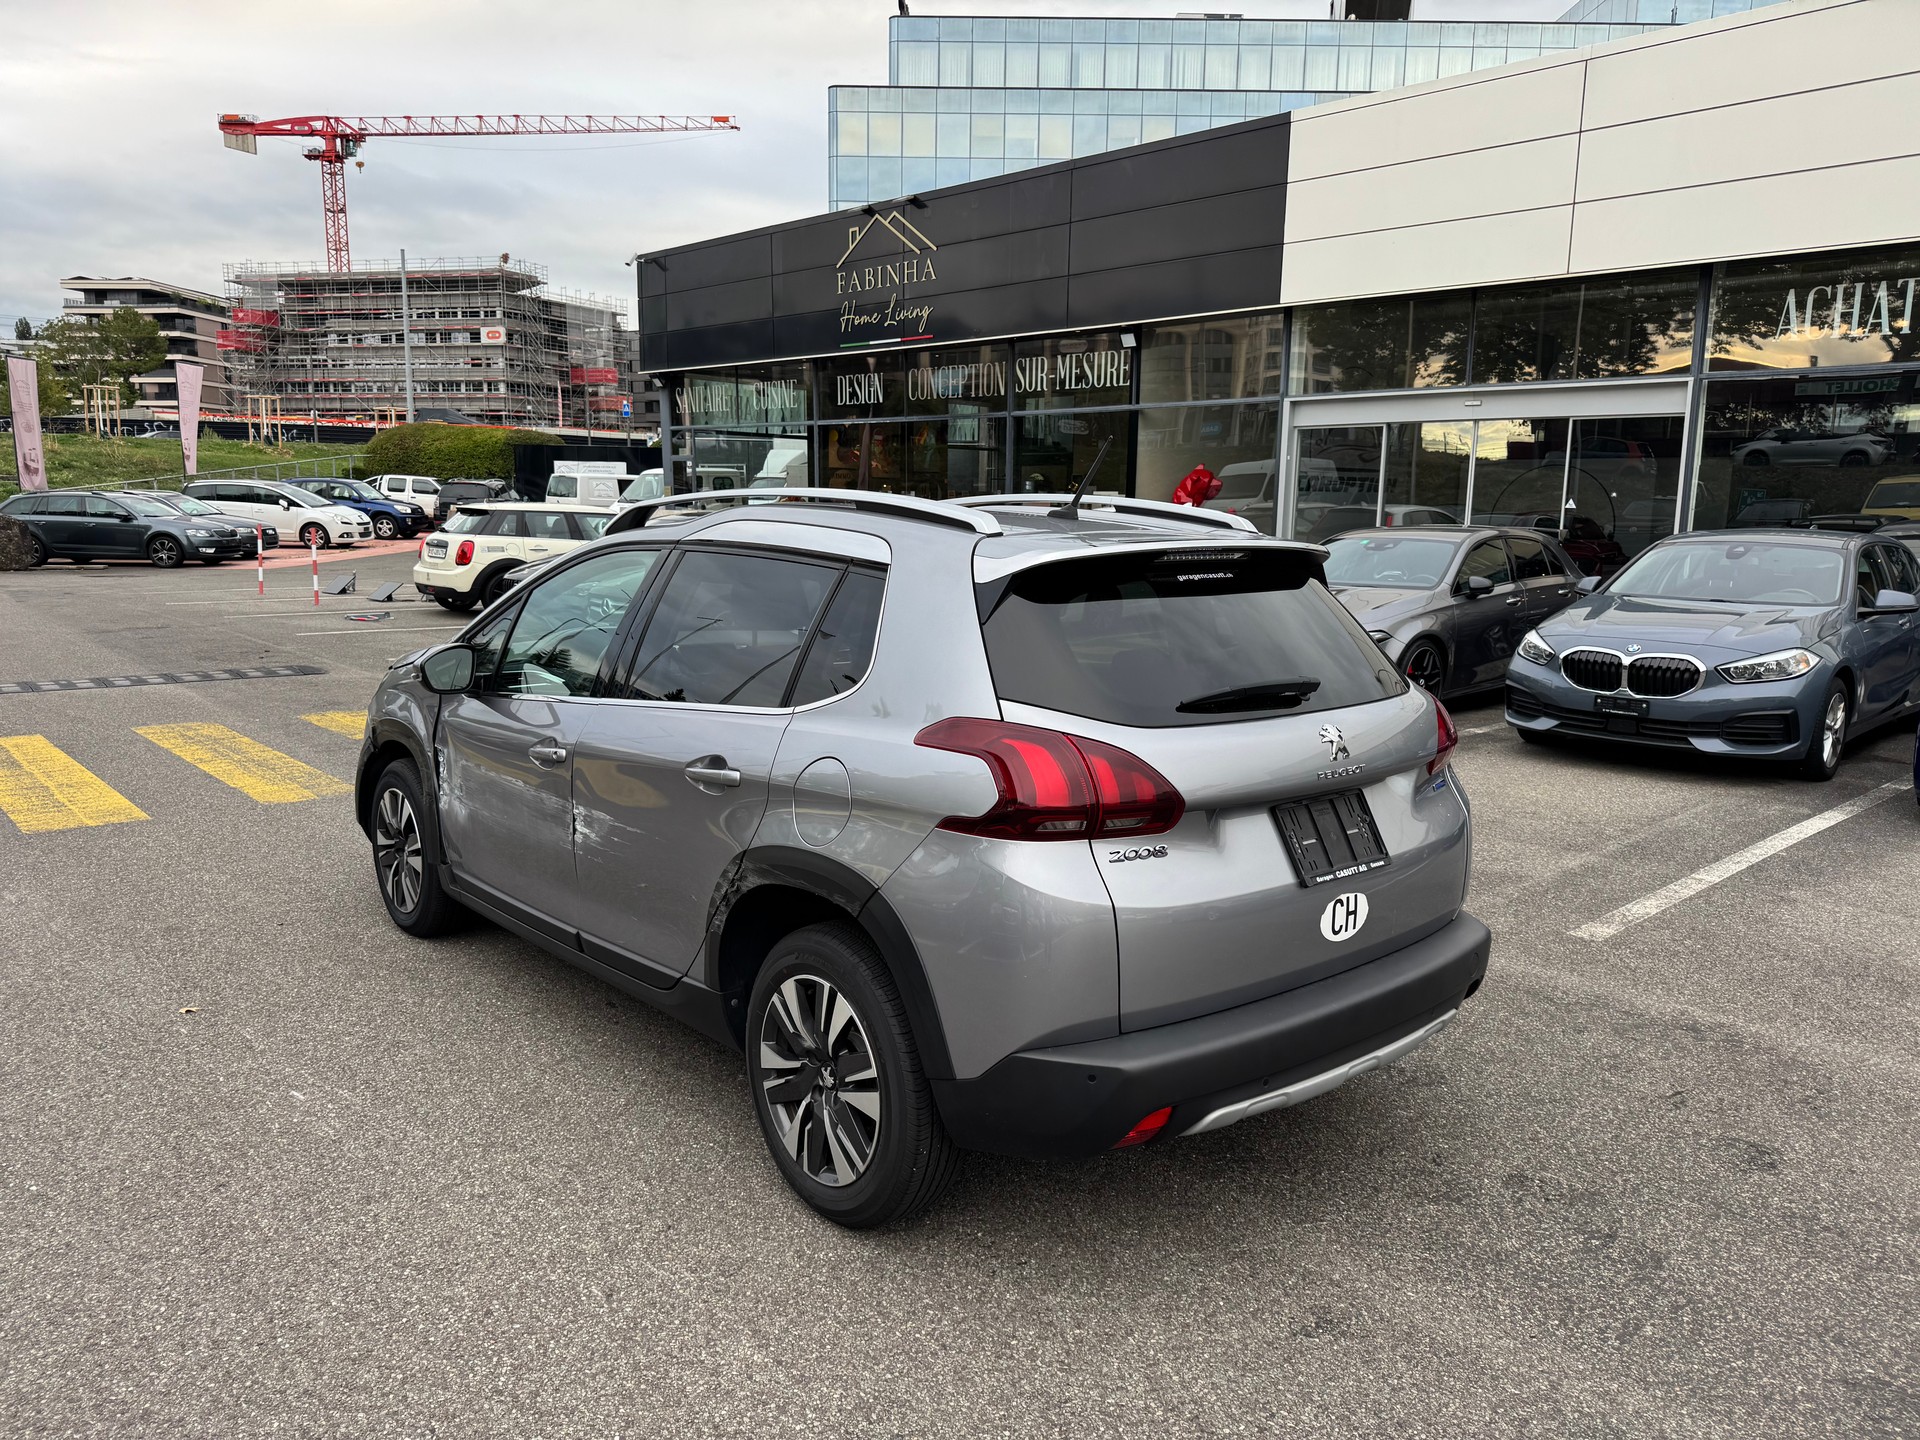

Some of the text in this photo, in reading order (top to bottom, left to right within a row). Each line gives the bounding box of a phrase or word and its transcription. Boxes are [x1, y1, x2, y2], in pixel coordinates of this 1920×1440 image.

[836, 257, 937, 295] FABINHA
[840, 293, 934, 333] Home Living
[1773, 277, 1920, 342] ACHAT
[675, 384, 730, 414] SANITAIRE
[753, 379, 798, 410] CUISINE
[836, 372, 885, 406] DESIGN
[907, 361, 1007, 401] CONCEPTION
[1015, 349, 1132, 393] SUR-MESURE
[1317, 763, 1366, 781] PEUGEOT
[1109, 844, 1169, 863] 2008
[1335, 866, 1359, 878] CASUTT
[1359, 864, 1368, 873] AG
[1331, 893, 1358, 936] CH
